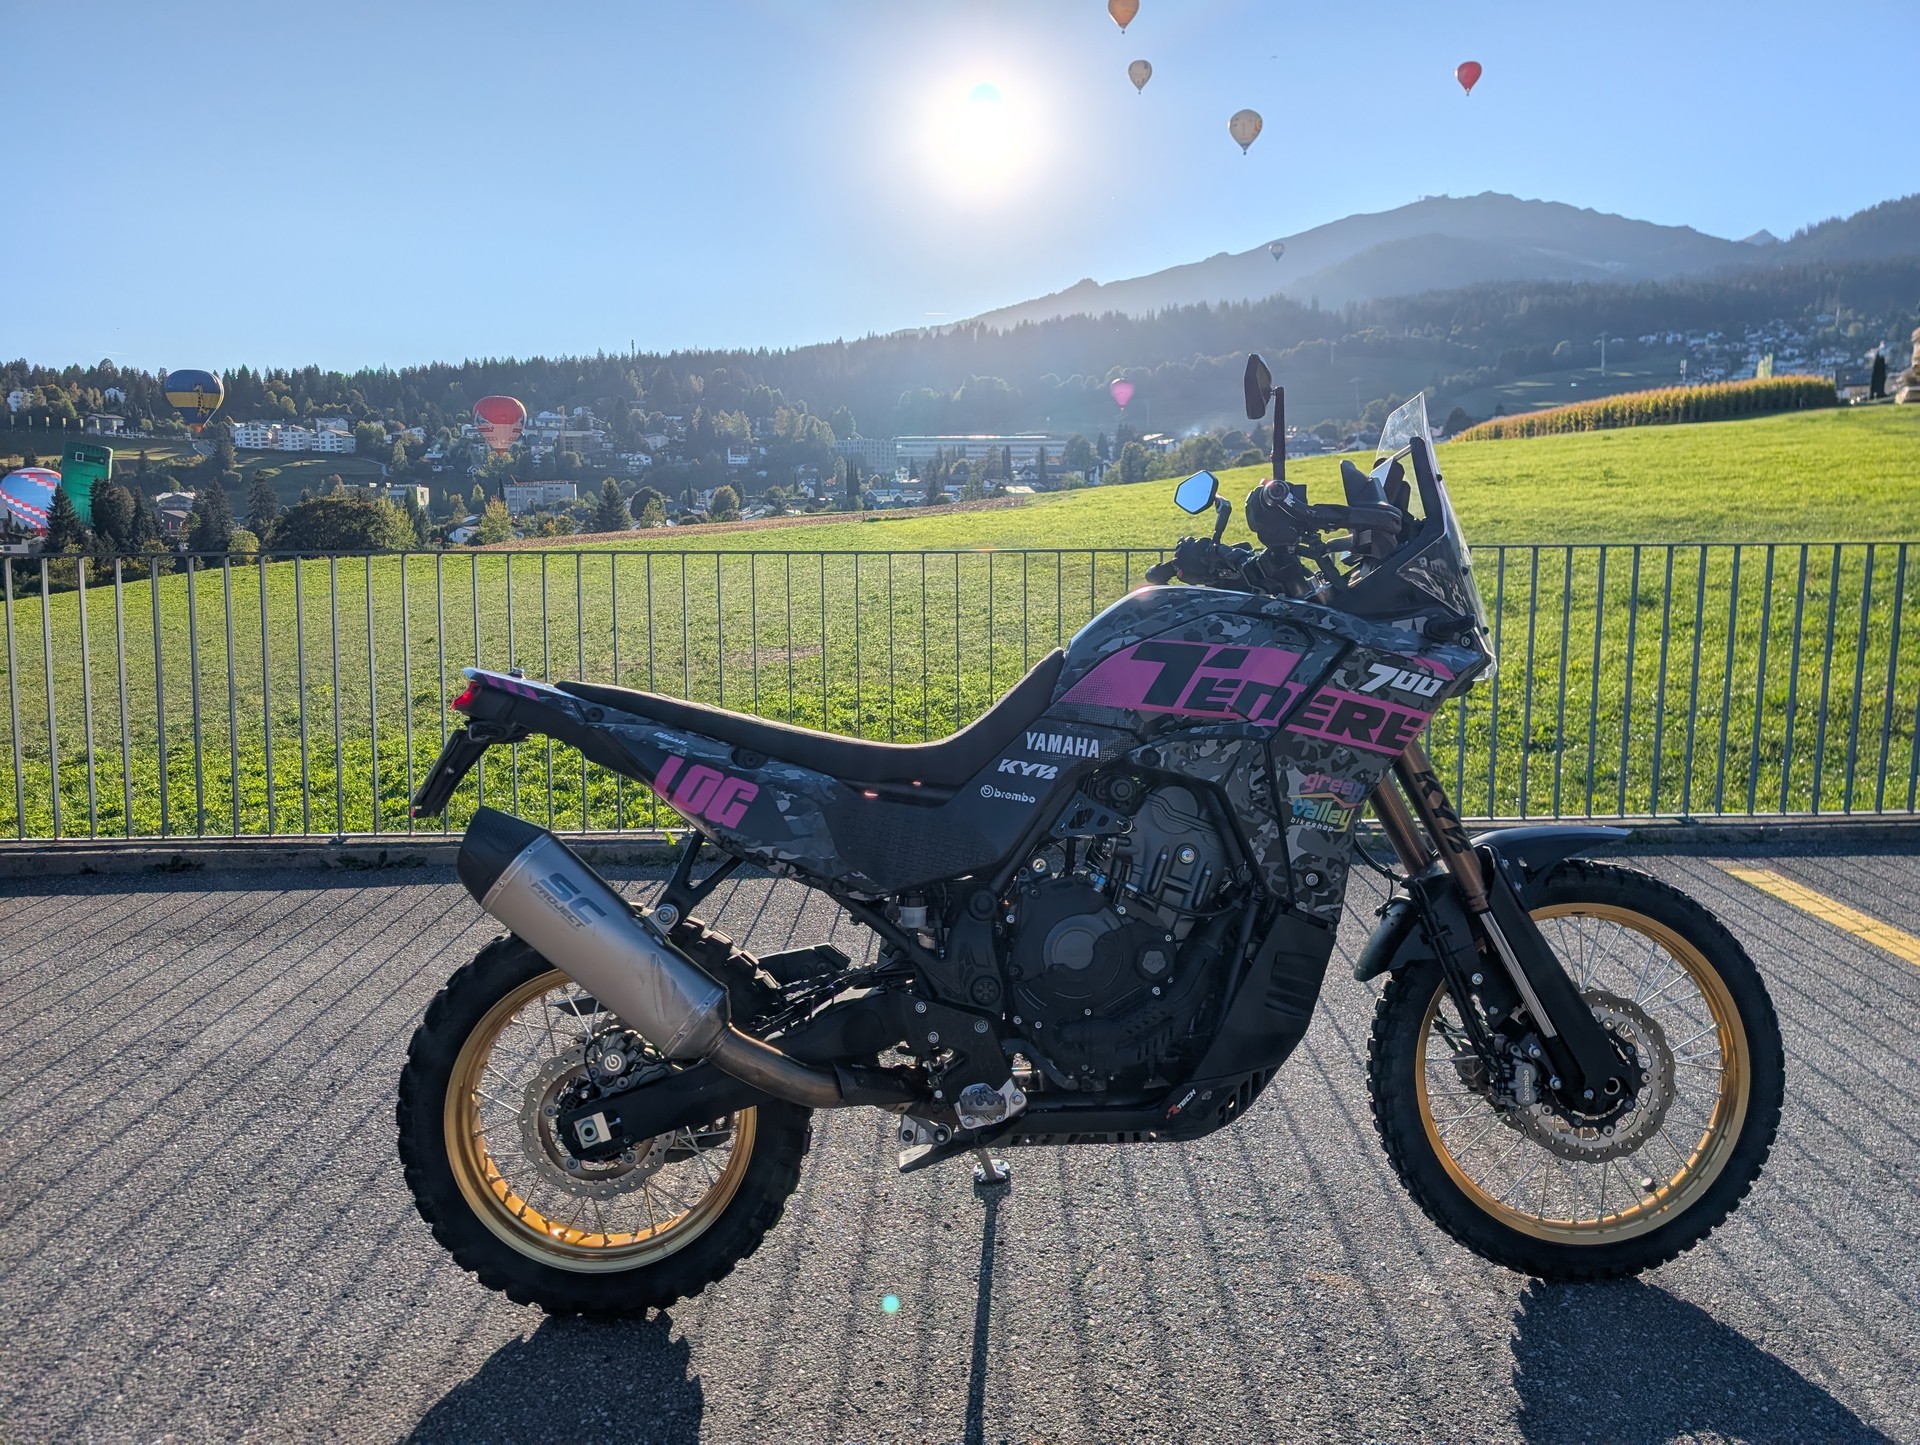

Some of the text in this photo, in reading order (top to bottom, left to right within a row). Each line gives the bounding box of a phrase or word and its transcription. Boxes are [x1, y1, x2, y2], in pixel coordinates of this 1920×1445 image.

[1359, 662, 1443, 698] 700
[1026, 731, 1100, 759] YAMAHA
[997, 759, 1059, 780] KYB
[653, 754, 759, 829] LOG
[994, 788, 1036, 804] brembo
[1300, 773, 1366, 802] green
[1290, 816, 1334, 833] bikeshop
[1292, 799, 1356, 832] valley
[1414, 770, 1471, 854] KYB
[531, 881, 586, 928] PROJECT
[538, 872, 607, 926] SC
